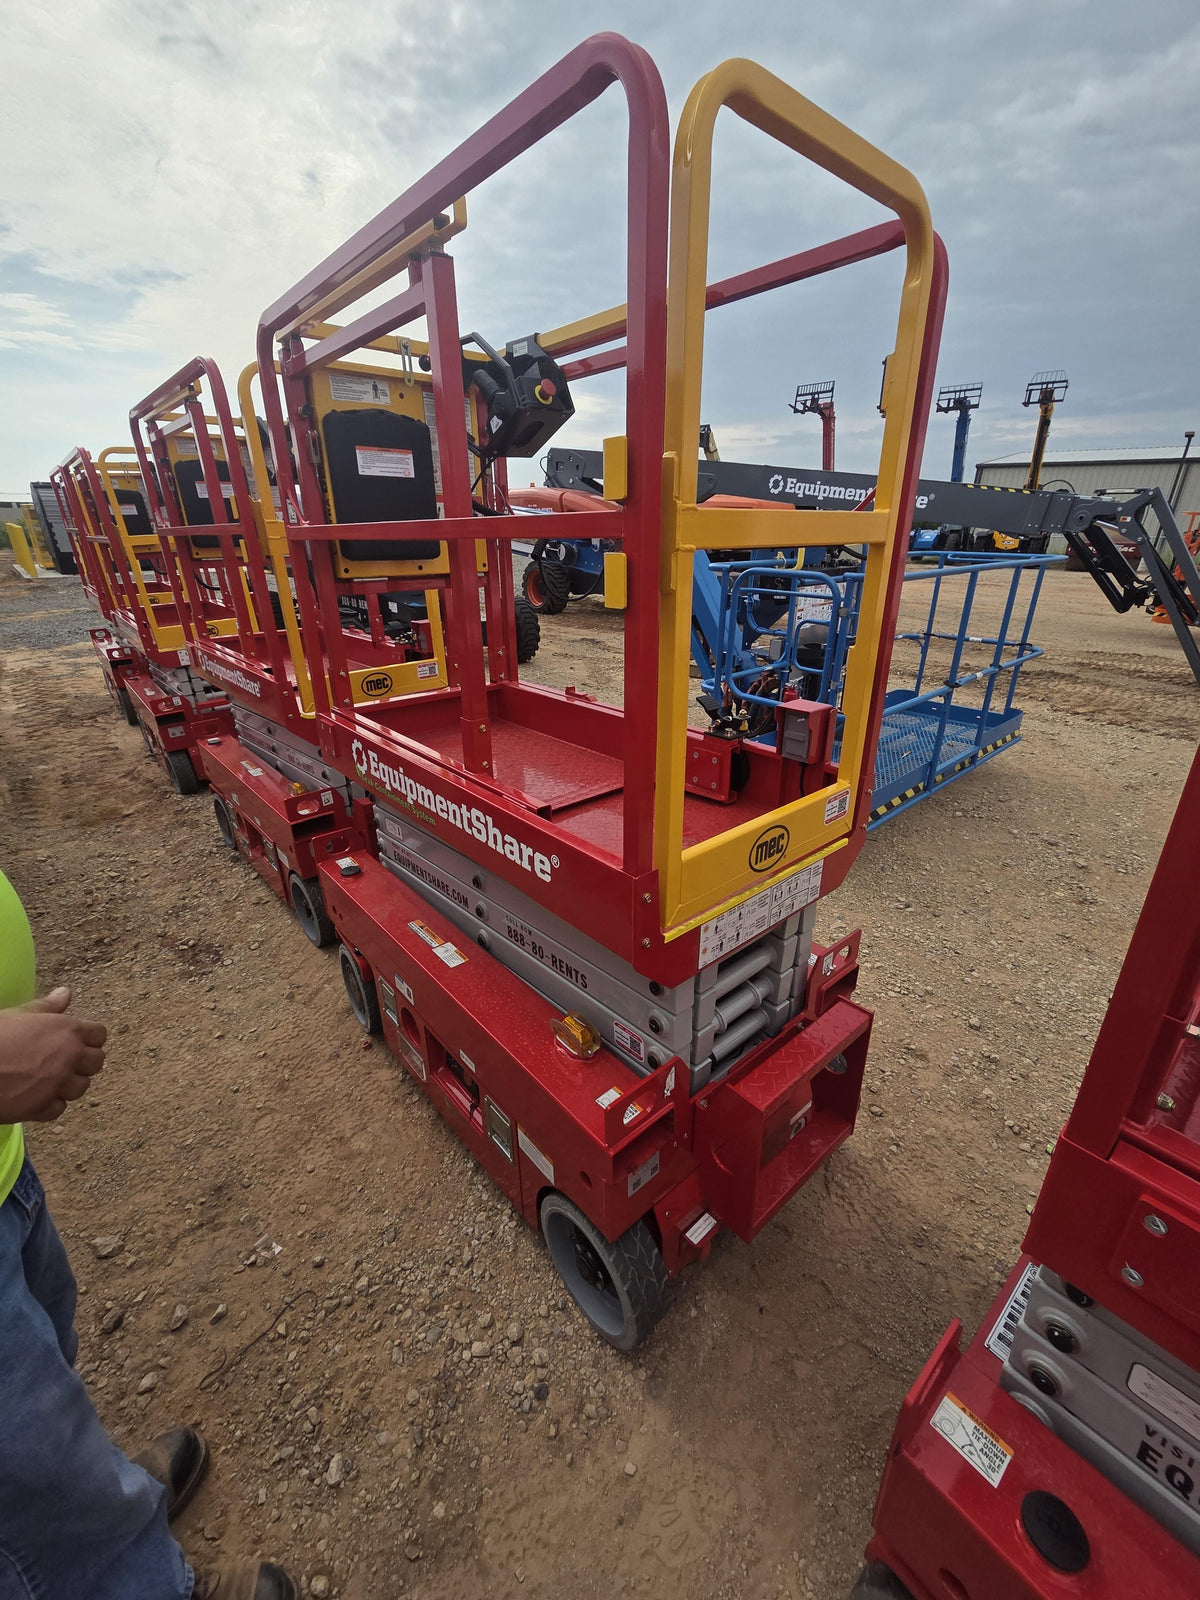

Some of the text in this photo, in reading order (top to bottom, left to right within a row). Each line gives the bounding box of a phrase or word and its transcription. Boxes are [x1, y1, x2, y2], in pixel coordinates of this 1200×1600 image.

[393, 850, 470, 909] EQUIPMENTSHARE.COM
[507, 925, 588, 989] 888-80-RENTS
[968, 1411, 1000, 1444] WARNING
[973, 1425, 1008, 1459] MAXIMUM
[971, 1430, 1005, 1465] TIE-DOWN
[979, 1447, 1002, 1470] ANGLE
[1136, 1440, 1200, 1507] EQ
